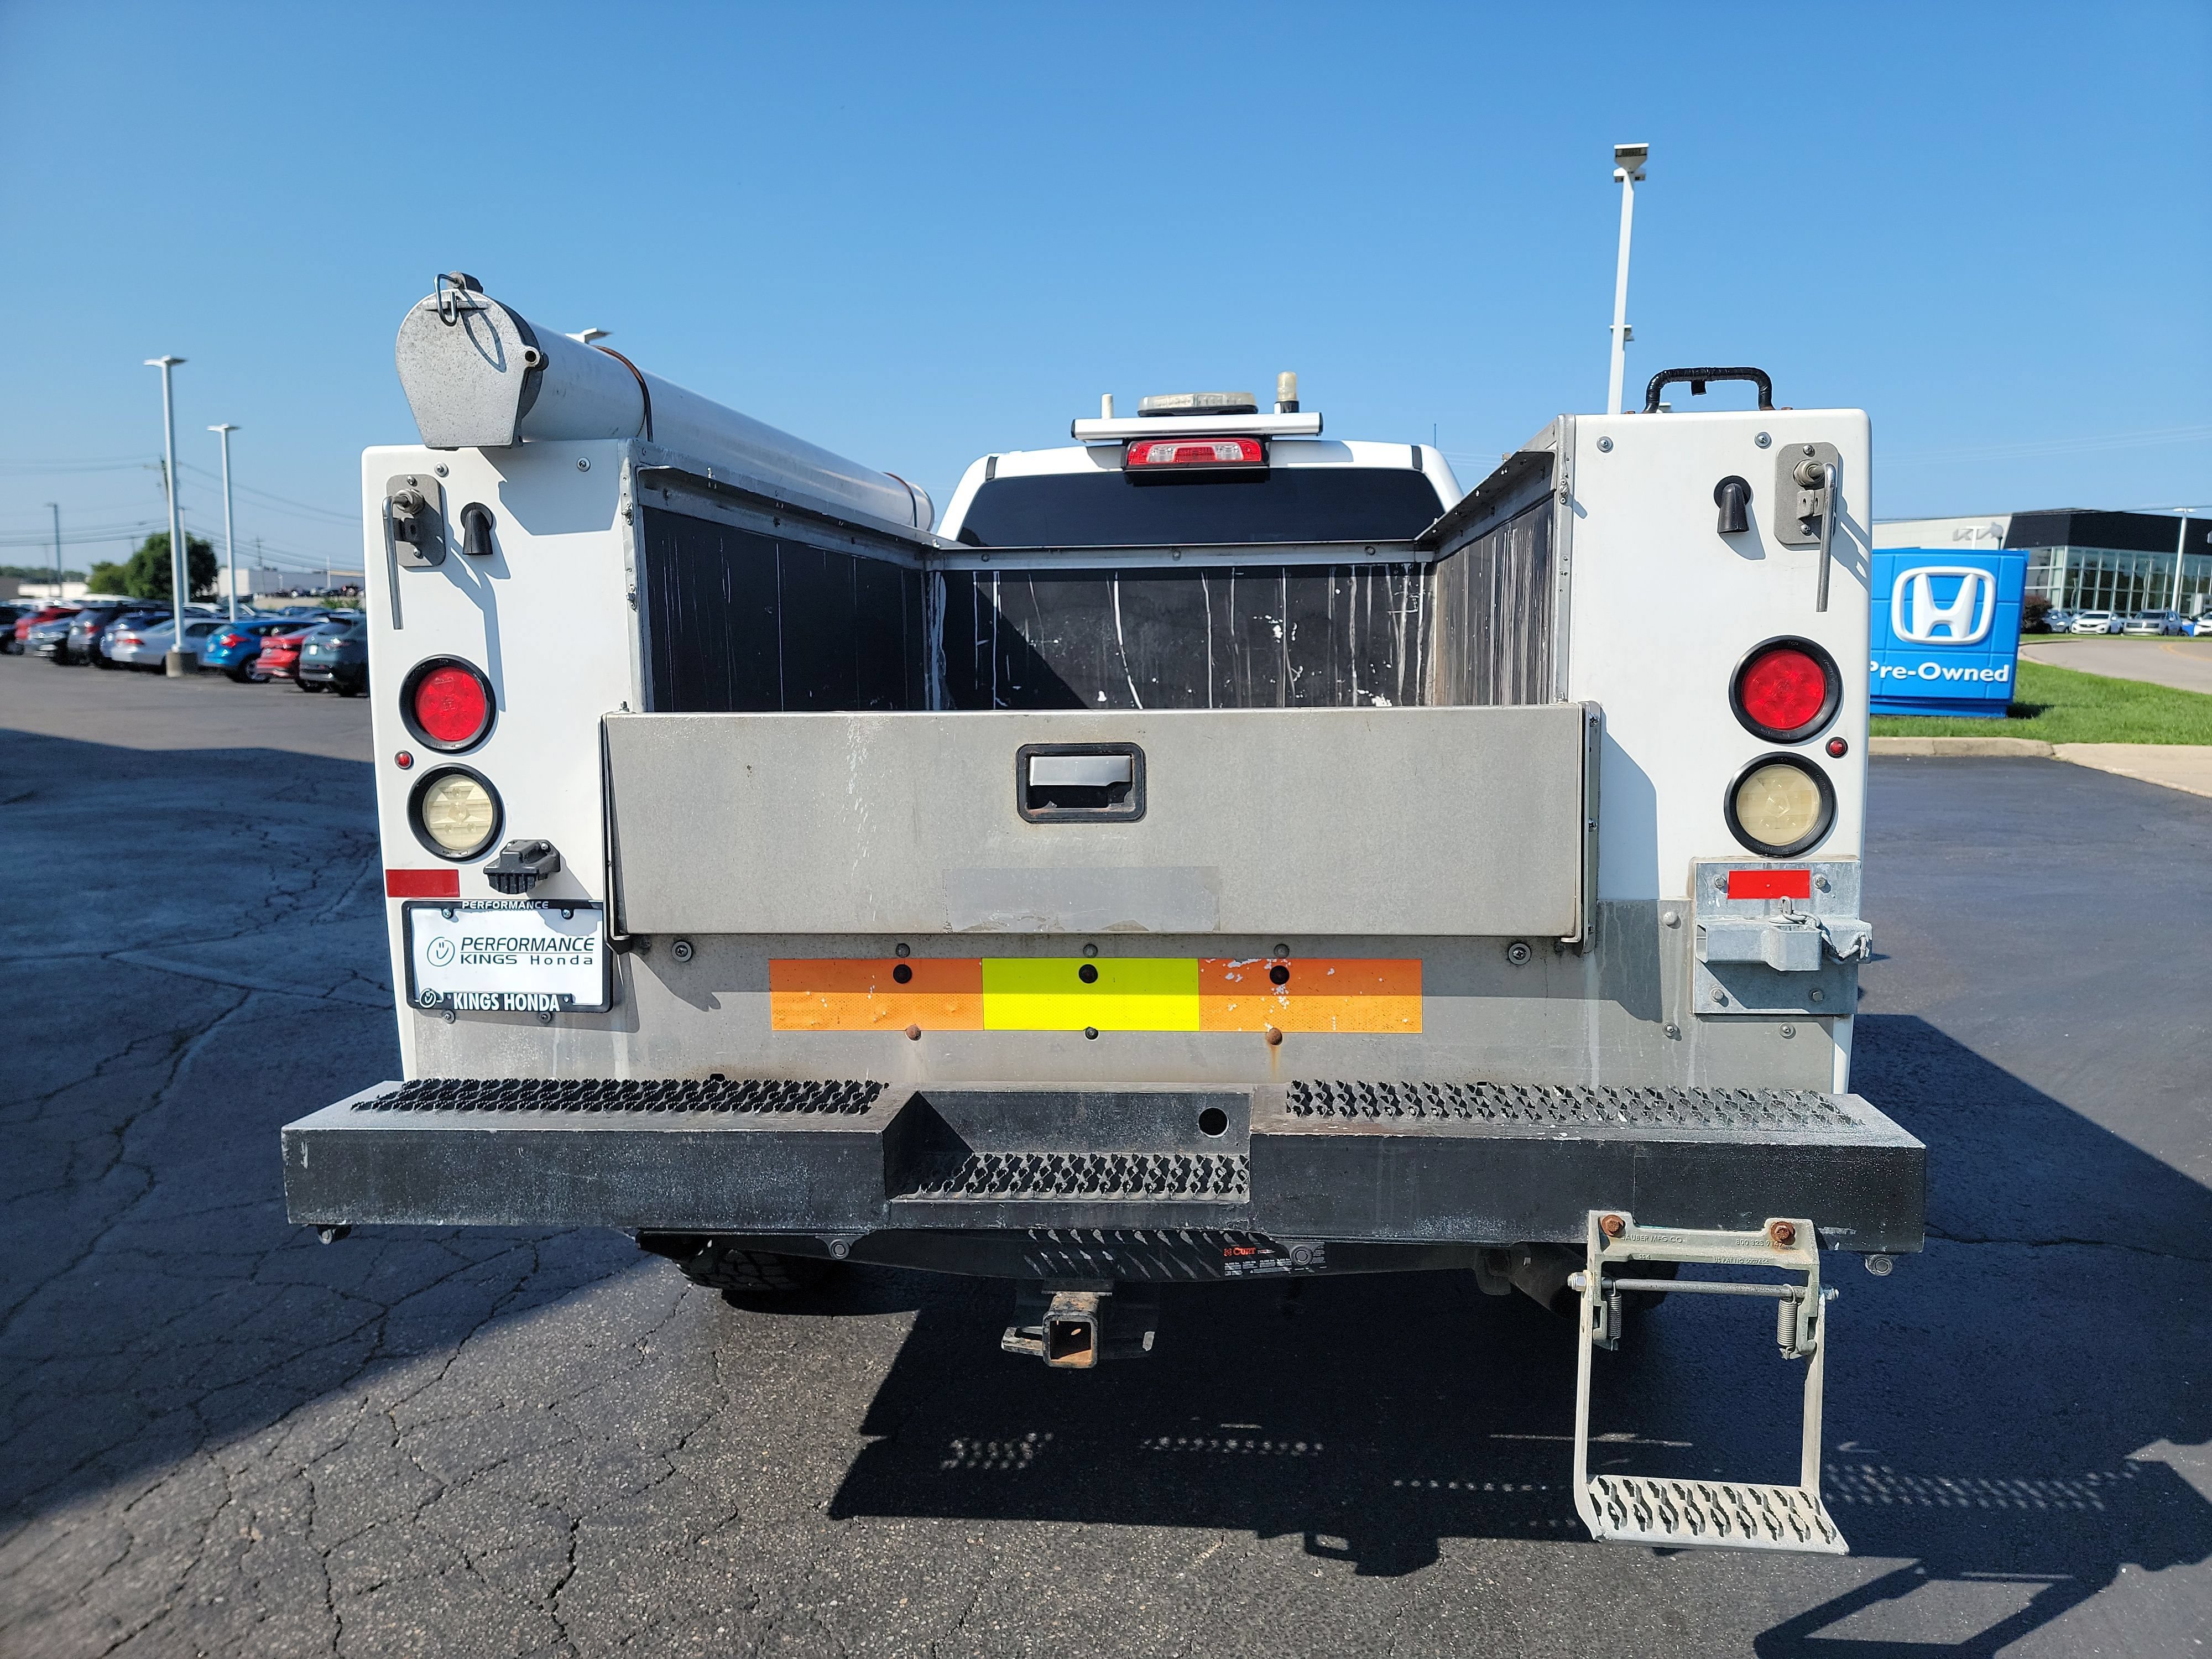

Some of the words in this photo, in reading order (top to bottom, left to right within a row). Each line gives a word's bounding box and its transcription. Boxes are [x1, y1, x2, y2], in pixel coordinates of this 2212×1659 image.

[462, 900, 549, 910] PERFORMANCE
[461, 937, 594, 952] PERFORMANCE
[460, 954, 517, 964] KINGS
[530, 954, 593, 966] Honda
[453, 993, 499, 1011] KINGS
[504, 993, 560, 1012] HONDA
